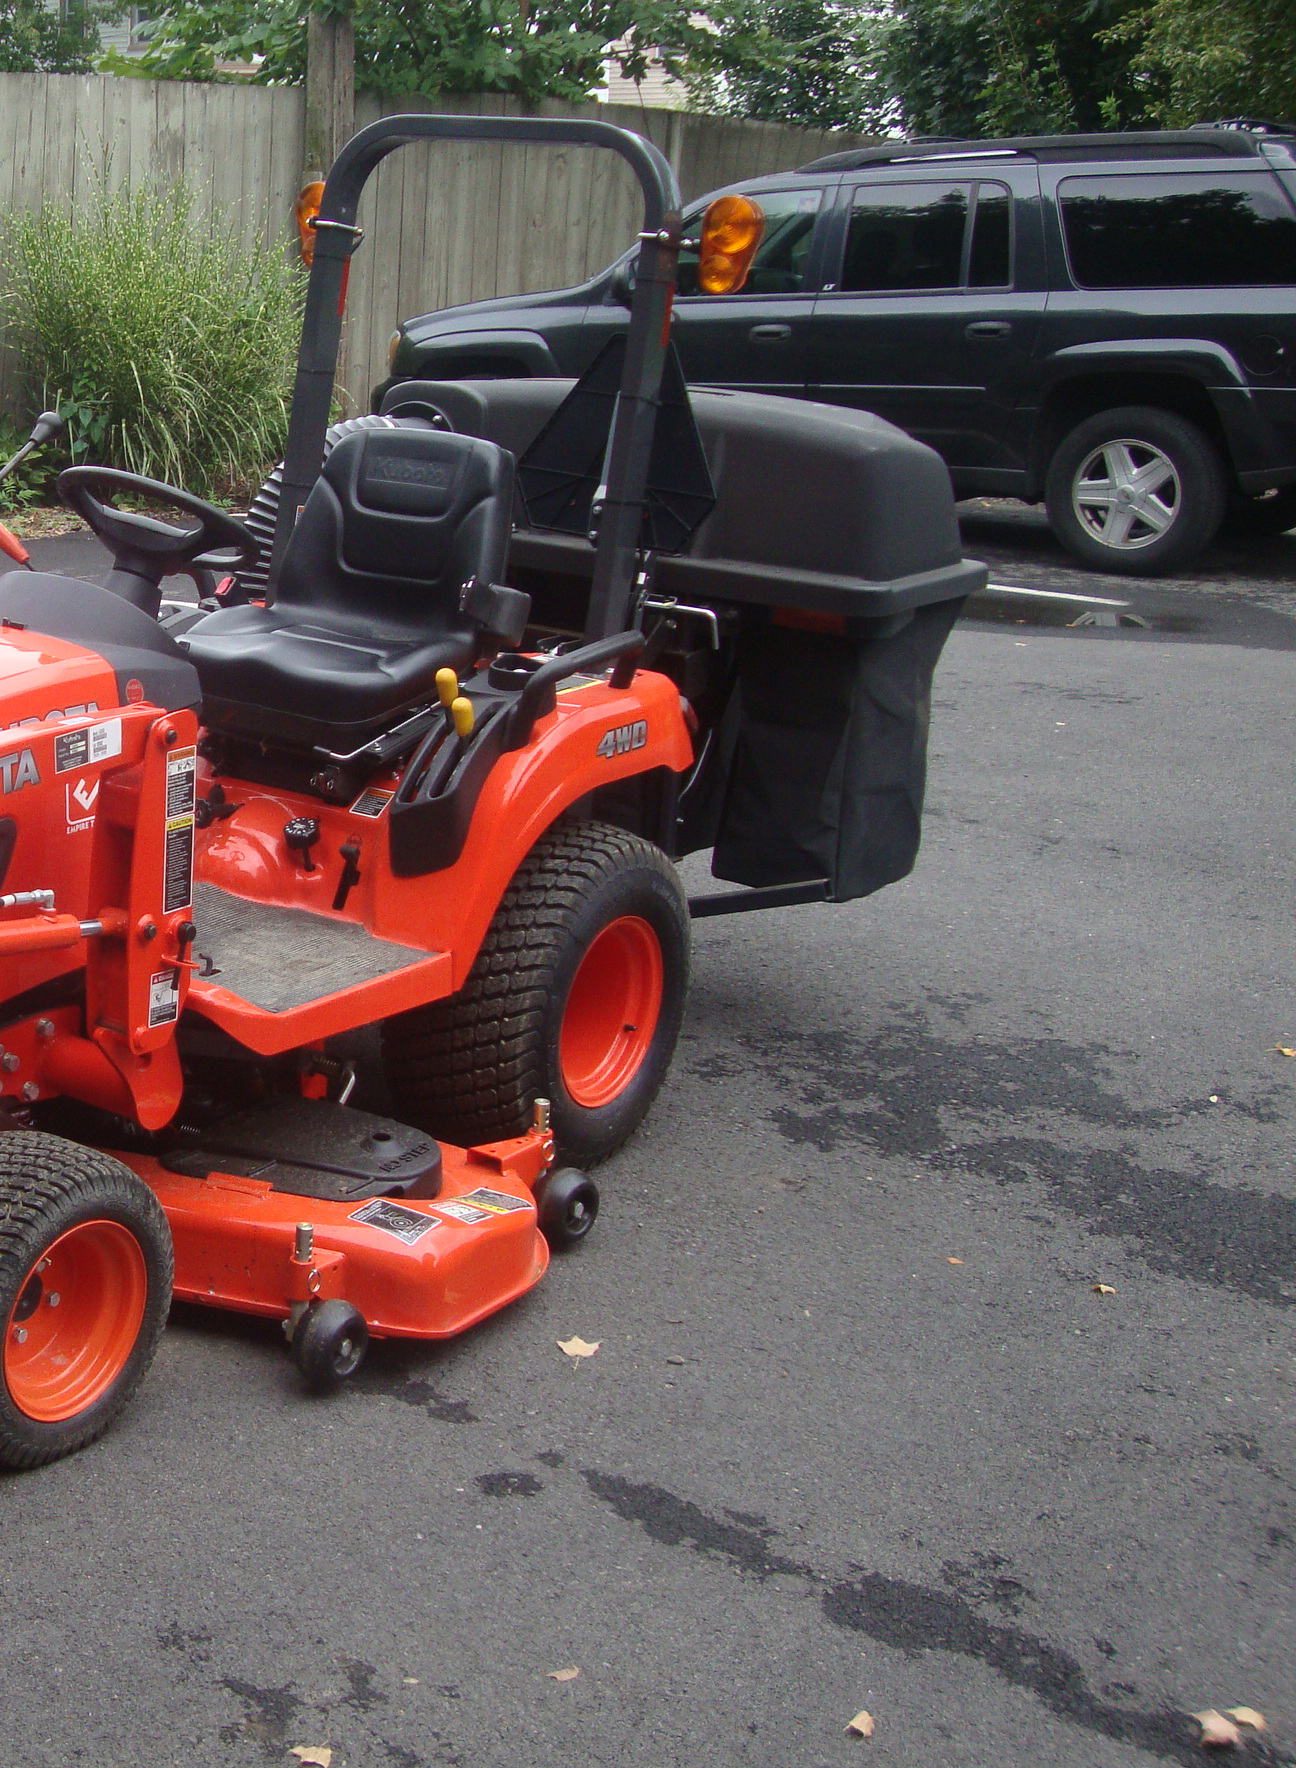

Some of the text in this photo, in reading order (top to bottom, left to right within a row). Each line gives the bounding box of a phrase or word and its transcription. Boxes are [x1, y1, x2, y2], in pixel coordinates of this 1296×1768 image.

[596, 719, 647, 758] 4WD
[66, 821, 89, 835] EMPIRE
[173, 817, 193, 828] CAUTION
[398, 1142, 431, 1163] STEP
